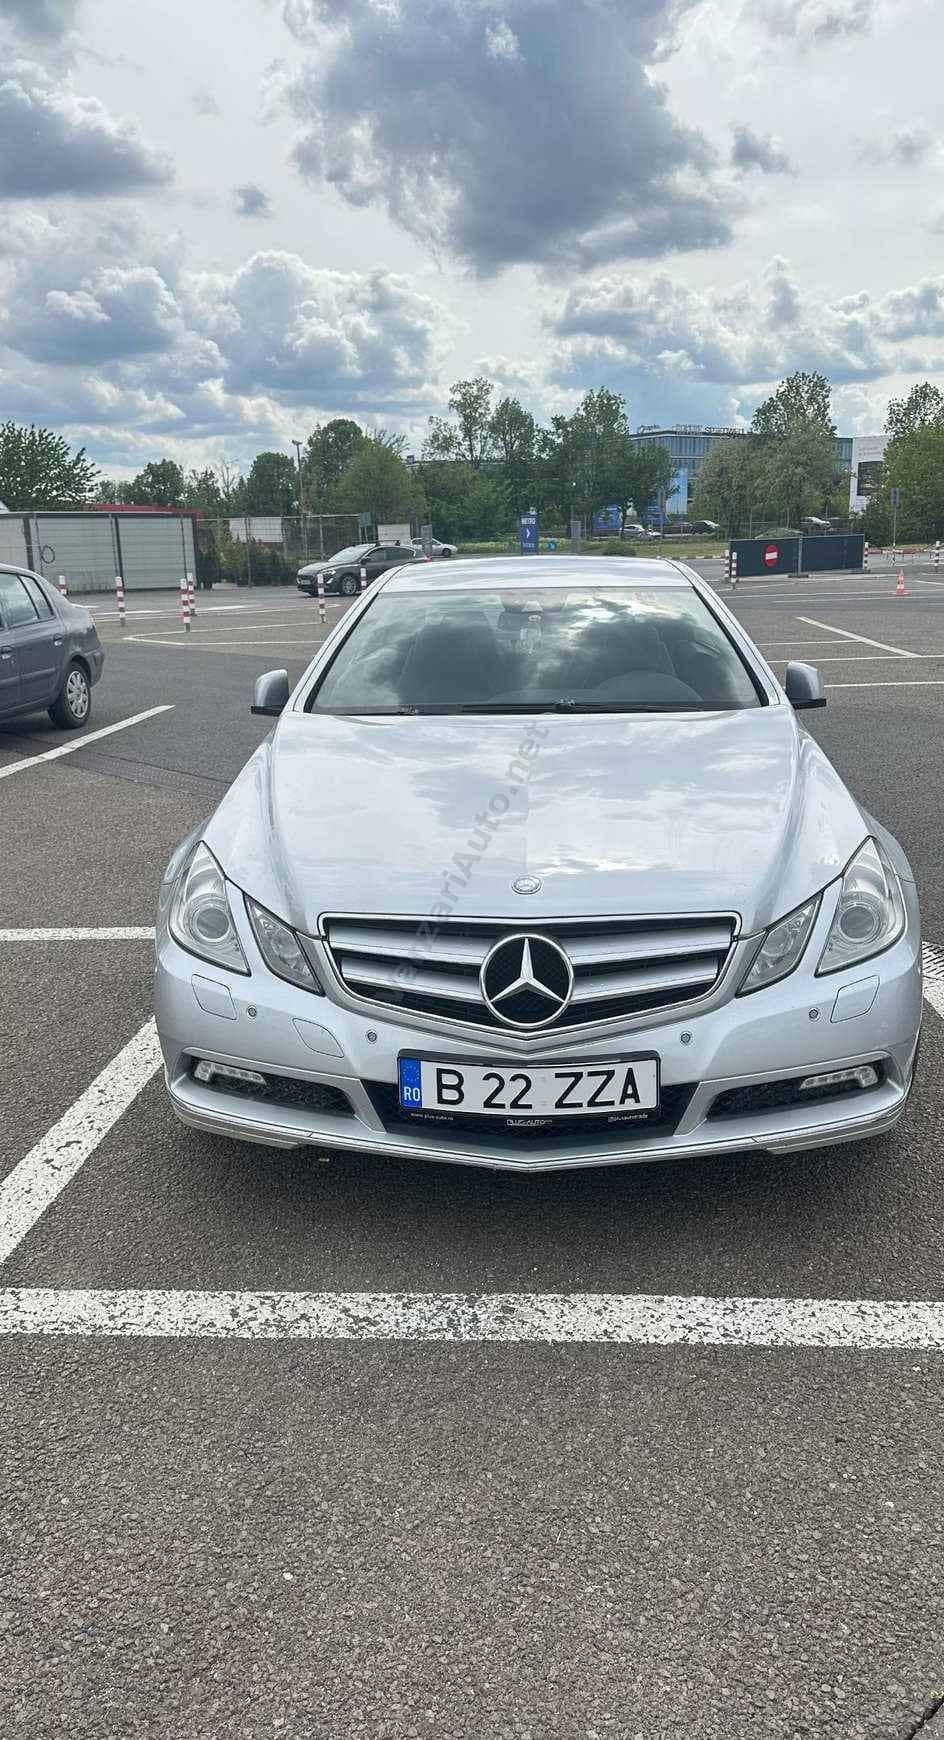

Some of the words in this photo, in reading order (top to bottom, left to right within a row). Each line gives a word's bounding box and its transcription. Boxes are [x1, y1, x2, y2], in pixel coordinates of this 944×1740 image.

[403, 1086, 421, 1102] RO
[436, 1067, 465, 1106] B
[482, 1072, 533, 1110] 22
[554, 1067, 641, 1110] ZZA
